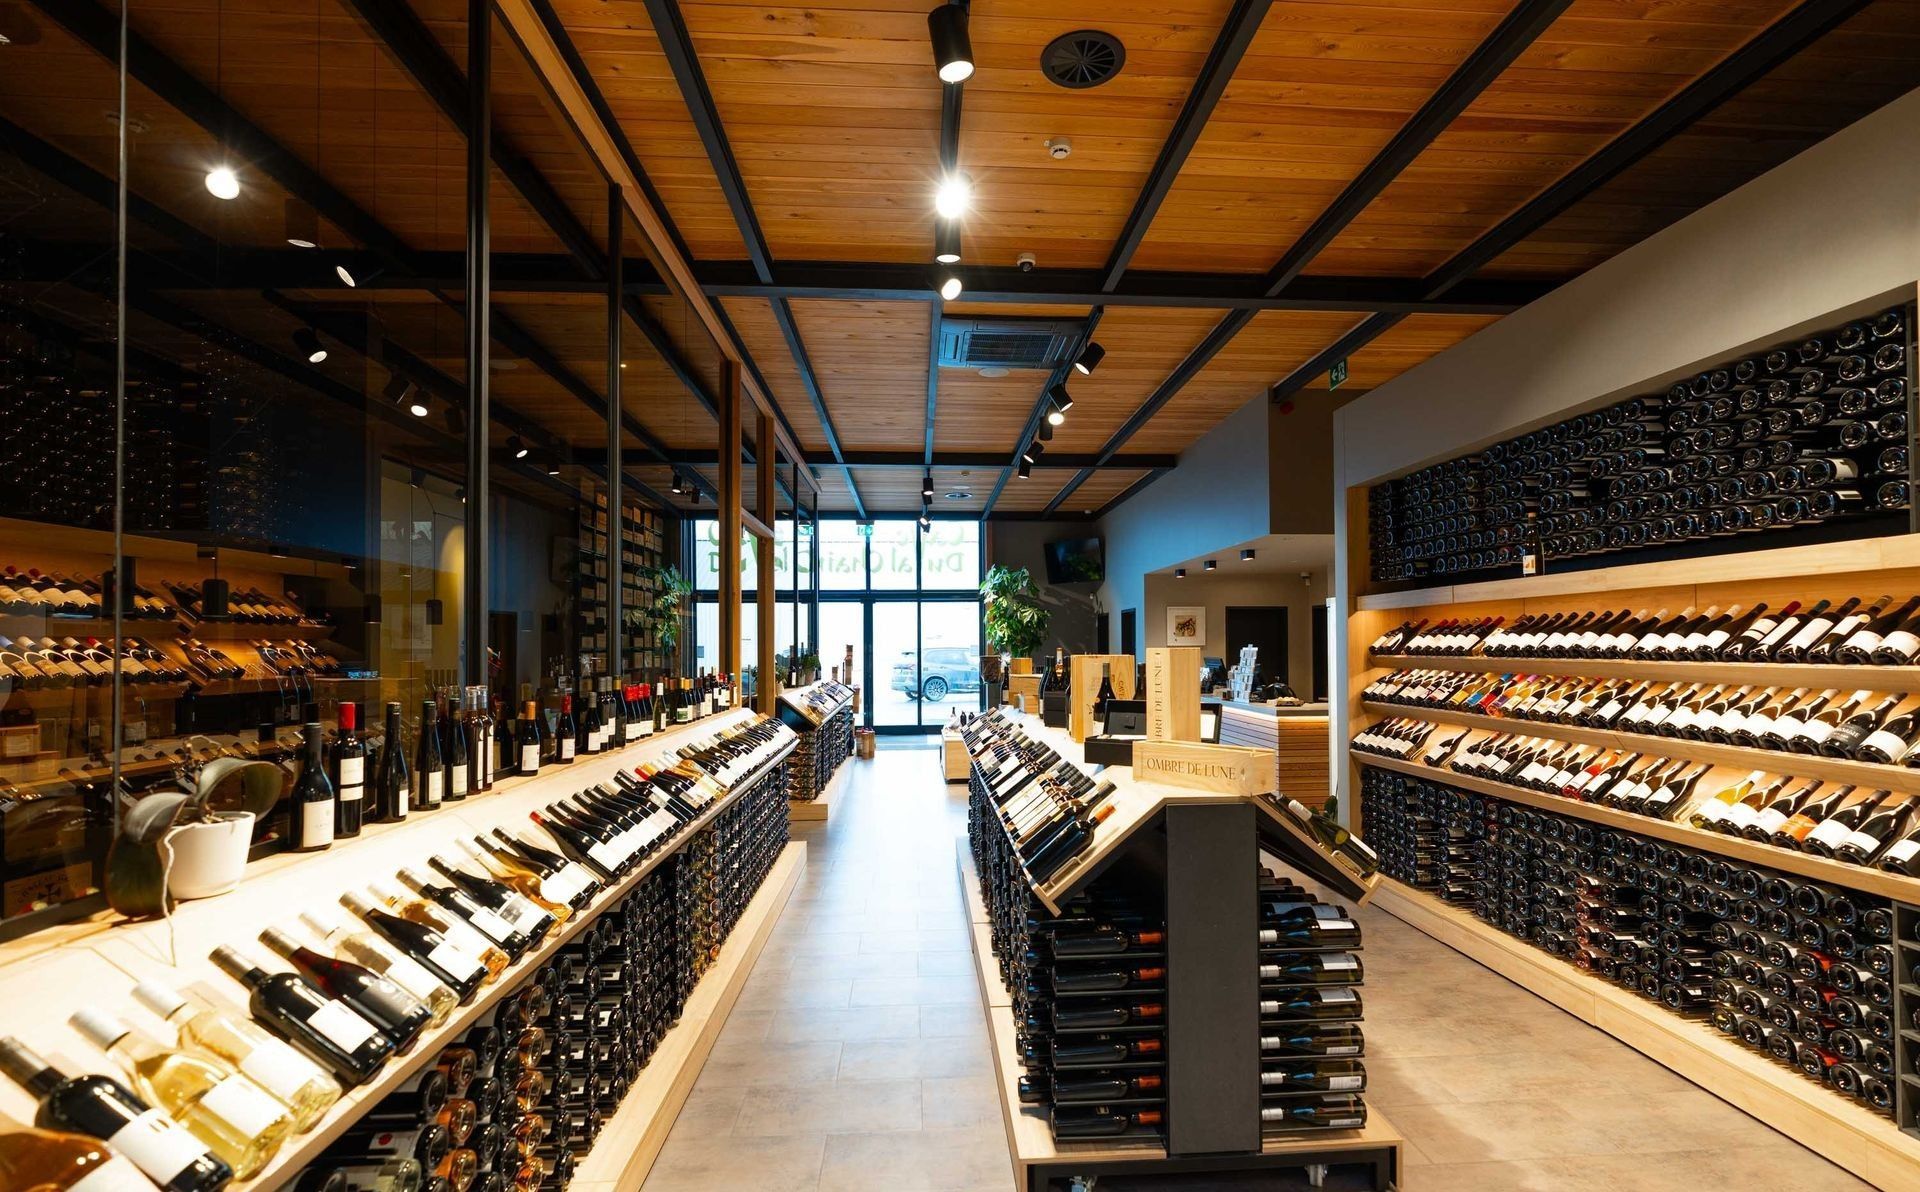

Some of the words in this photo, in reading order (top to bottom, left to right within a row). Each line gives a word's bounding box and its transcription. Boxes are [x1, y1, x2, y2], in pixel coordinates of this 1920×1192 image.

[1154, 715, 1163, 737] BRE
[1147, 758, 1184, 774] OMBRE
[1187, 762, 1201, 776] DE
[1205, 764, 1235, 780] LUNE
